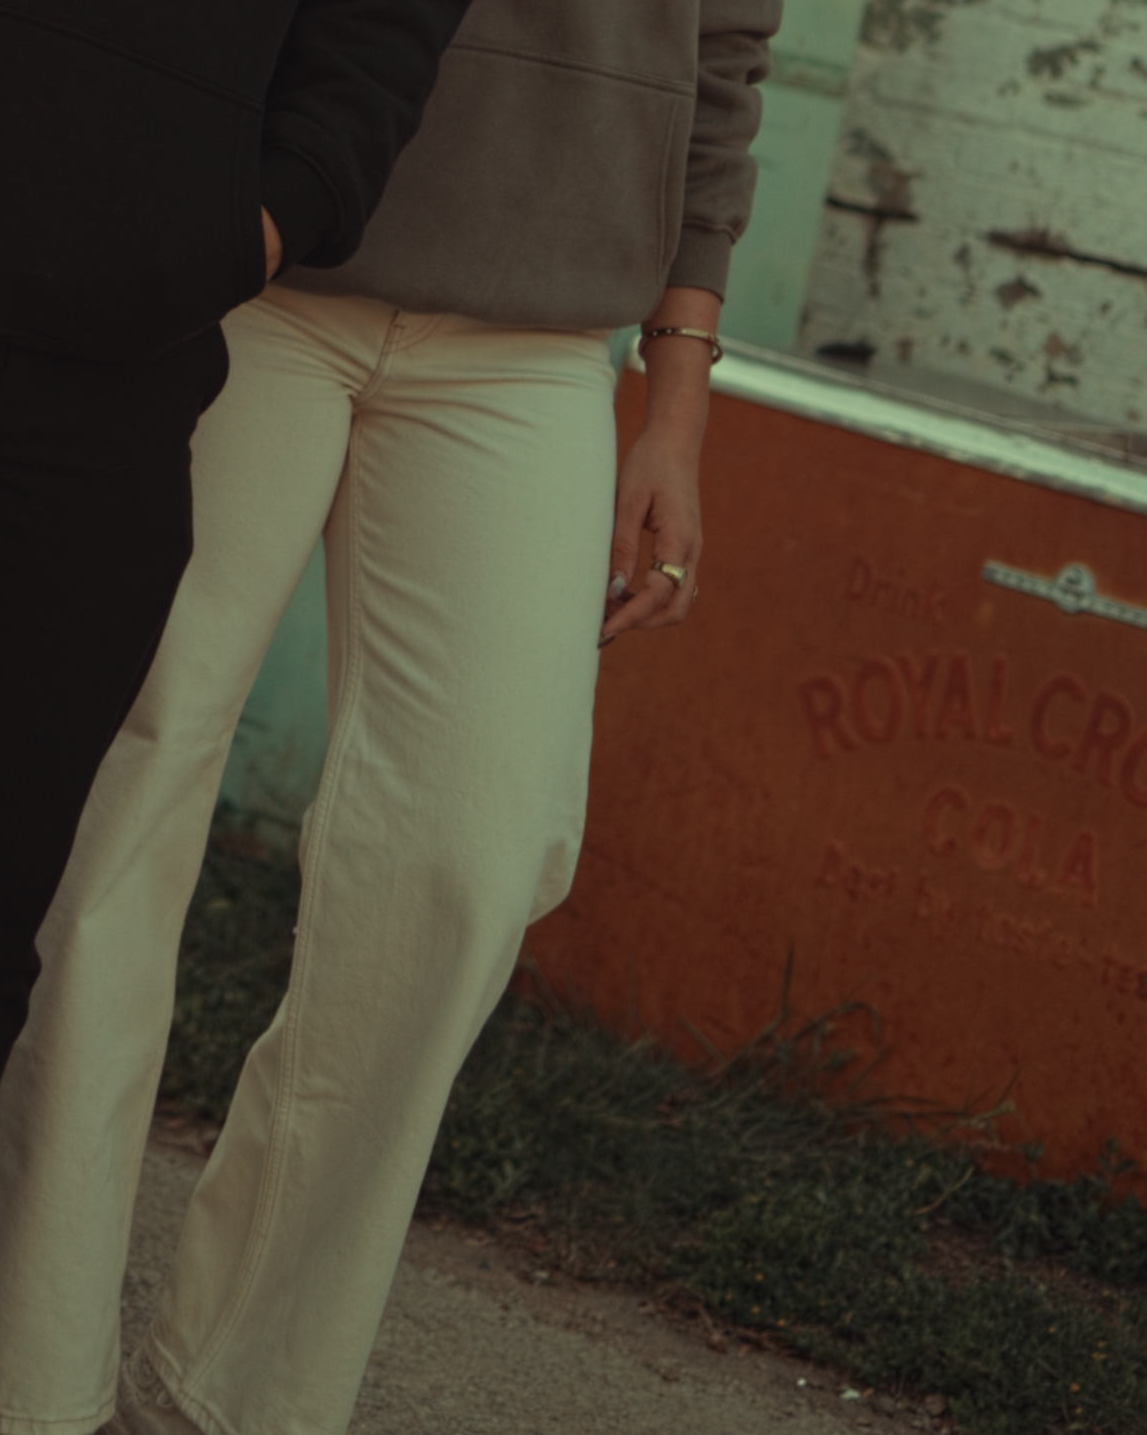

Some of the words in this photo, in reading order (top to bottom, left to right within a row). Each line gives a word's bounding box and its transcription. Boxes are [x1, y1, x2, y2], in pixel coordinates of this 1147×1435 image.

[844, 556, 948, 627] Drink
[797, 652, 1014, 760] ROYAL
[924, 786, 1099, 909] COLA
